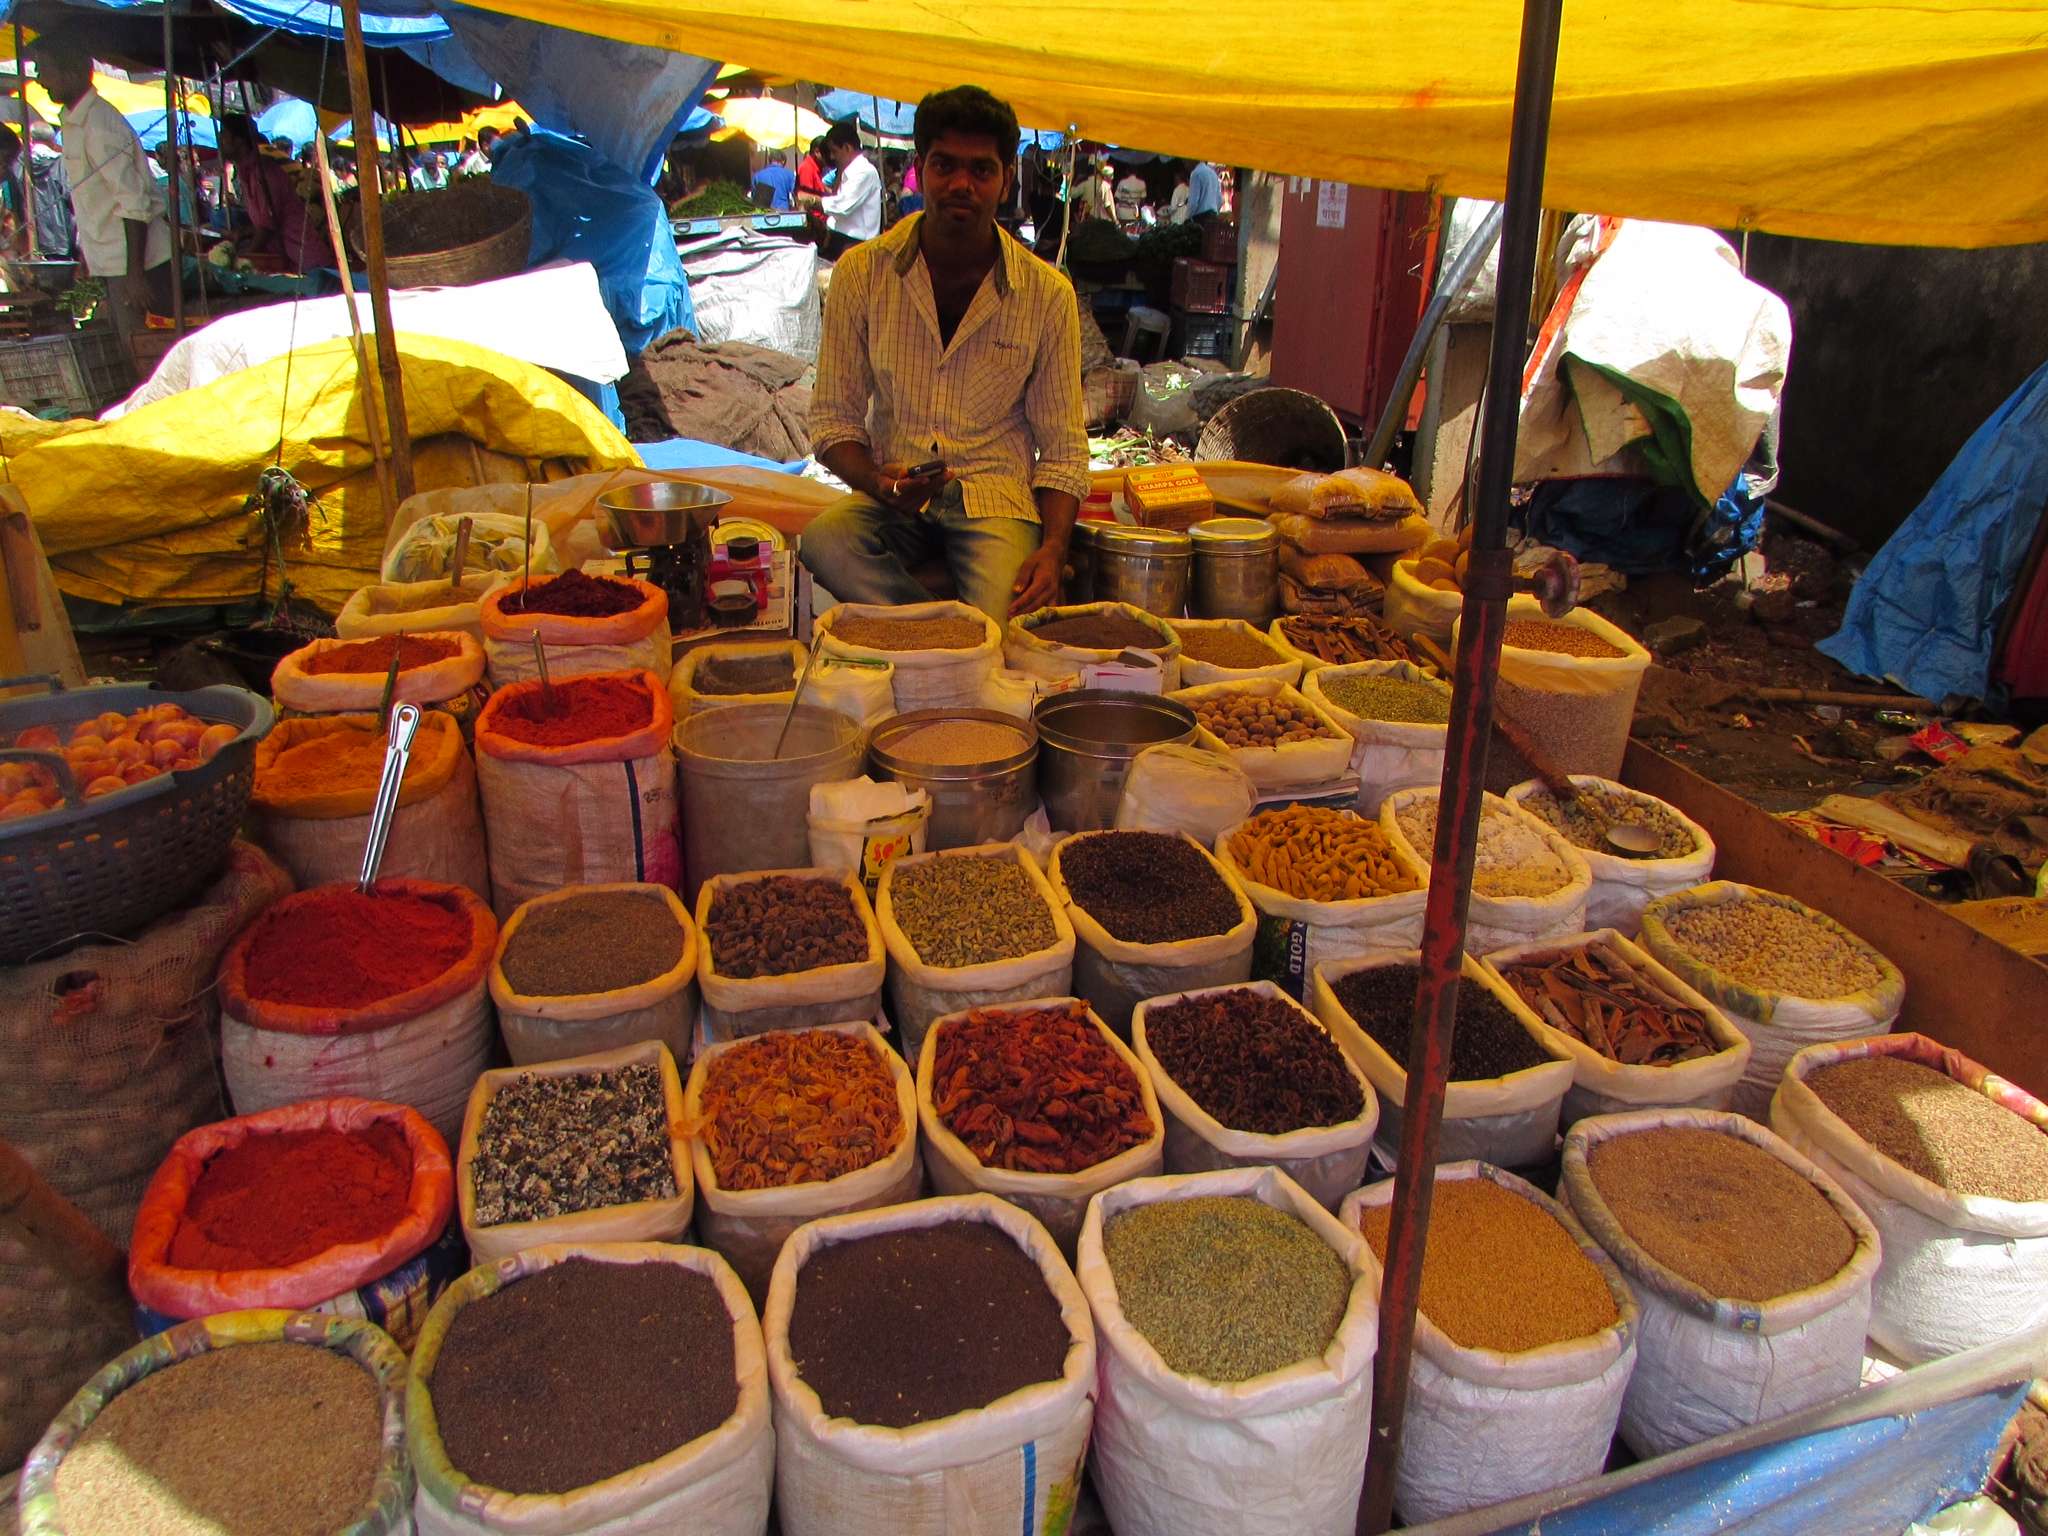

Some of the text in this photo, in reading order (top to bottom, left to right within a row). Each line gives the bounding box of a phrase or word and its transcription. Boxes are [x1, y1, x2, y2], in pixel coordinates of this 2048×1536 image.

[1138, 477, 1199, 491] CHAMPA GOLD
[1289, 931, 1303, 974] GOLD
